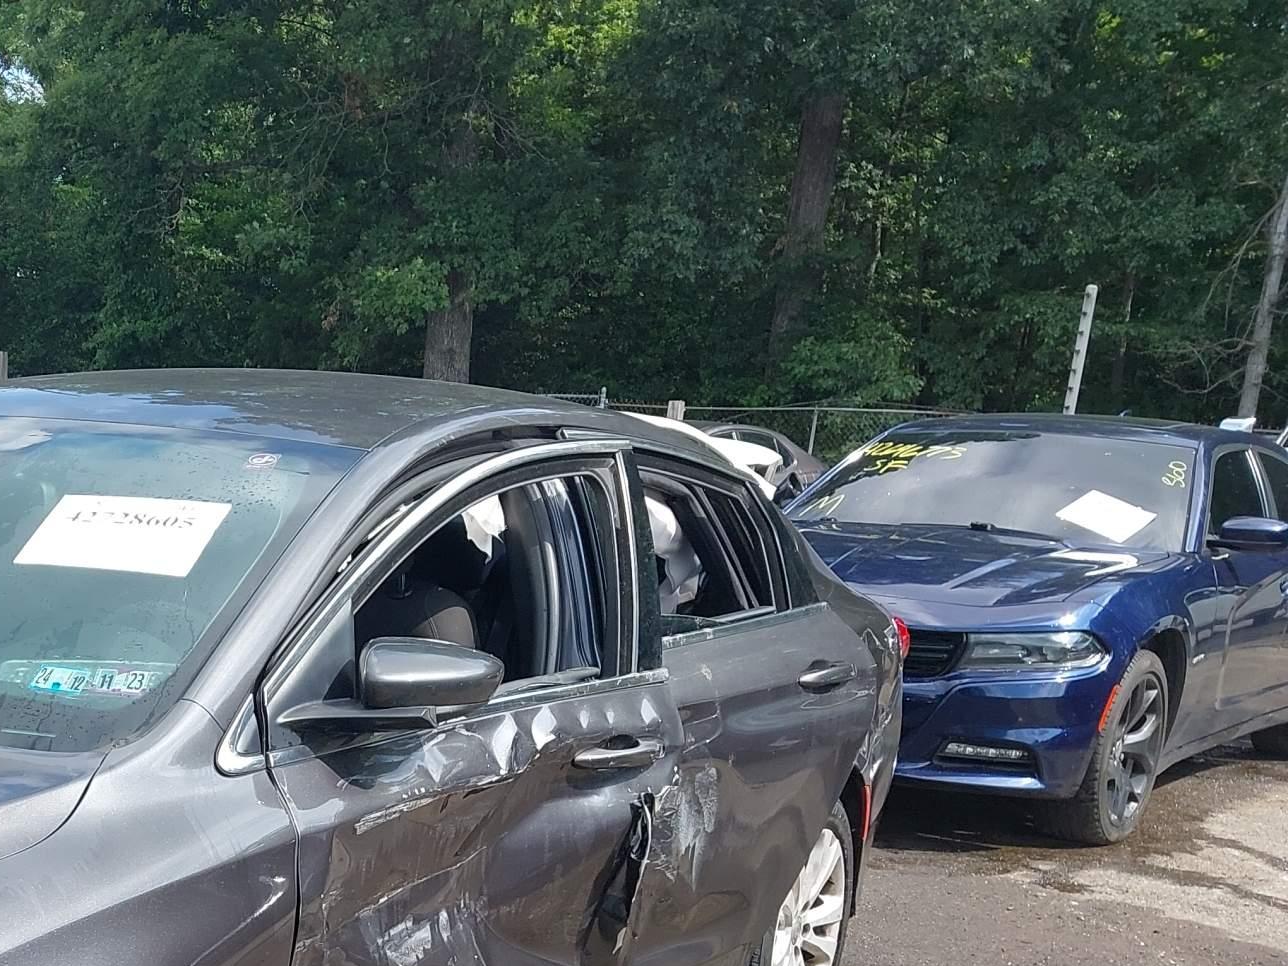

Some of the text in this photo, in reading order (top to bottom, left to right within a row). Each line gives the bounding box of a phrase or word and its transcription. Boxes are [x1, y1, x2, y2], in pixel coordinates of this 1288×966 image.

[863, 458, 910, 475] SF
[798, 493, 846, 518] M
[35, 667, 86, 691] 24 12
[99, 672, 145, 690] 11 23
